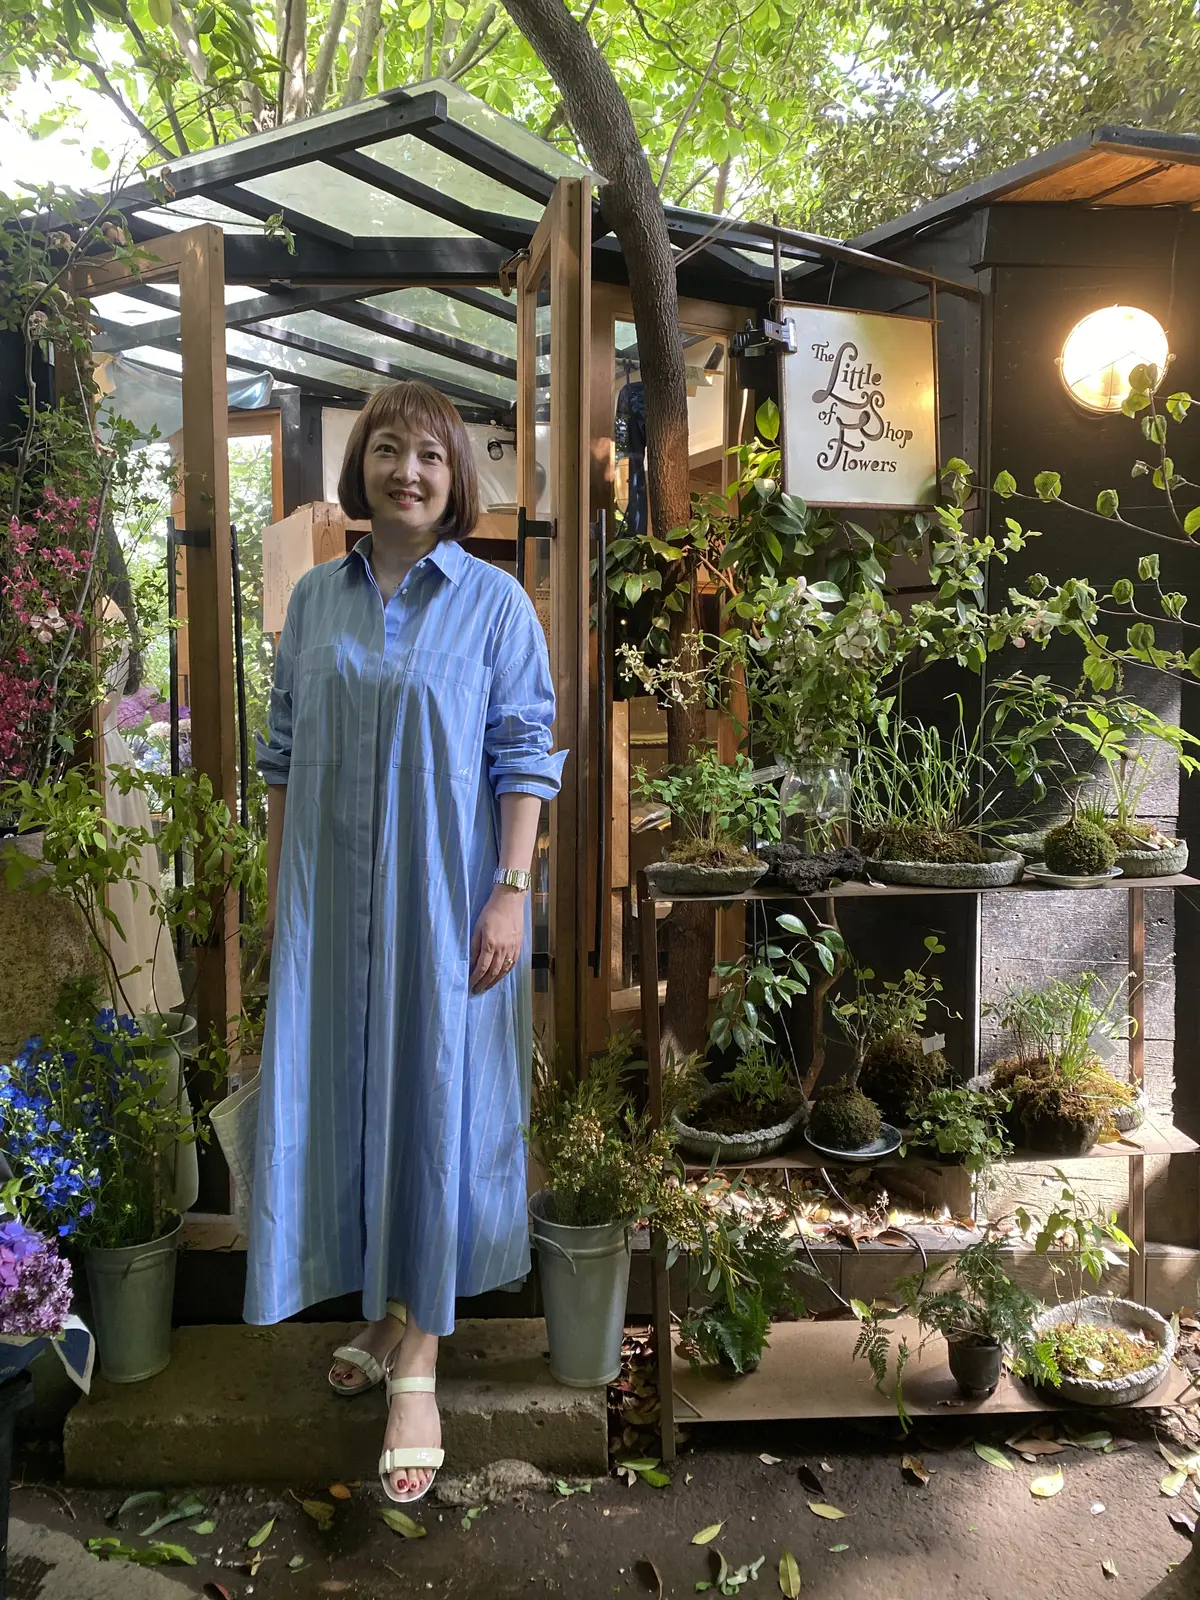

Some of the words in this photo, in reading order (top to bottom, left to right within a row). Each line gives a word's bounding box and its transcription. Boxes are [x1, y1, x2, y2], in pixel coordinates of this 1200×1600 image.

[812, 341, 834, 362] The
[812, 342, 882, 409] Little
[817, 410, 897, 472] Flowers
[818, 403, 837, 425] of
[861, 390, 914, 448] Shop
